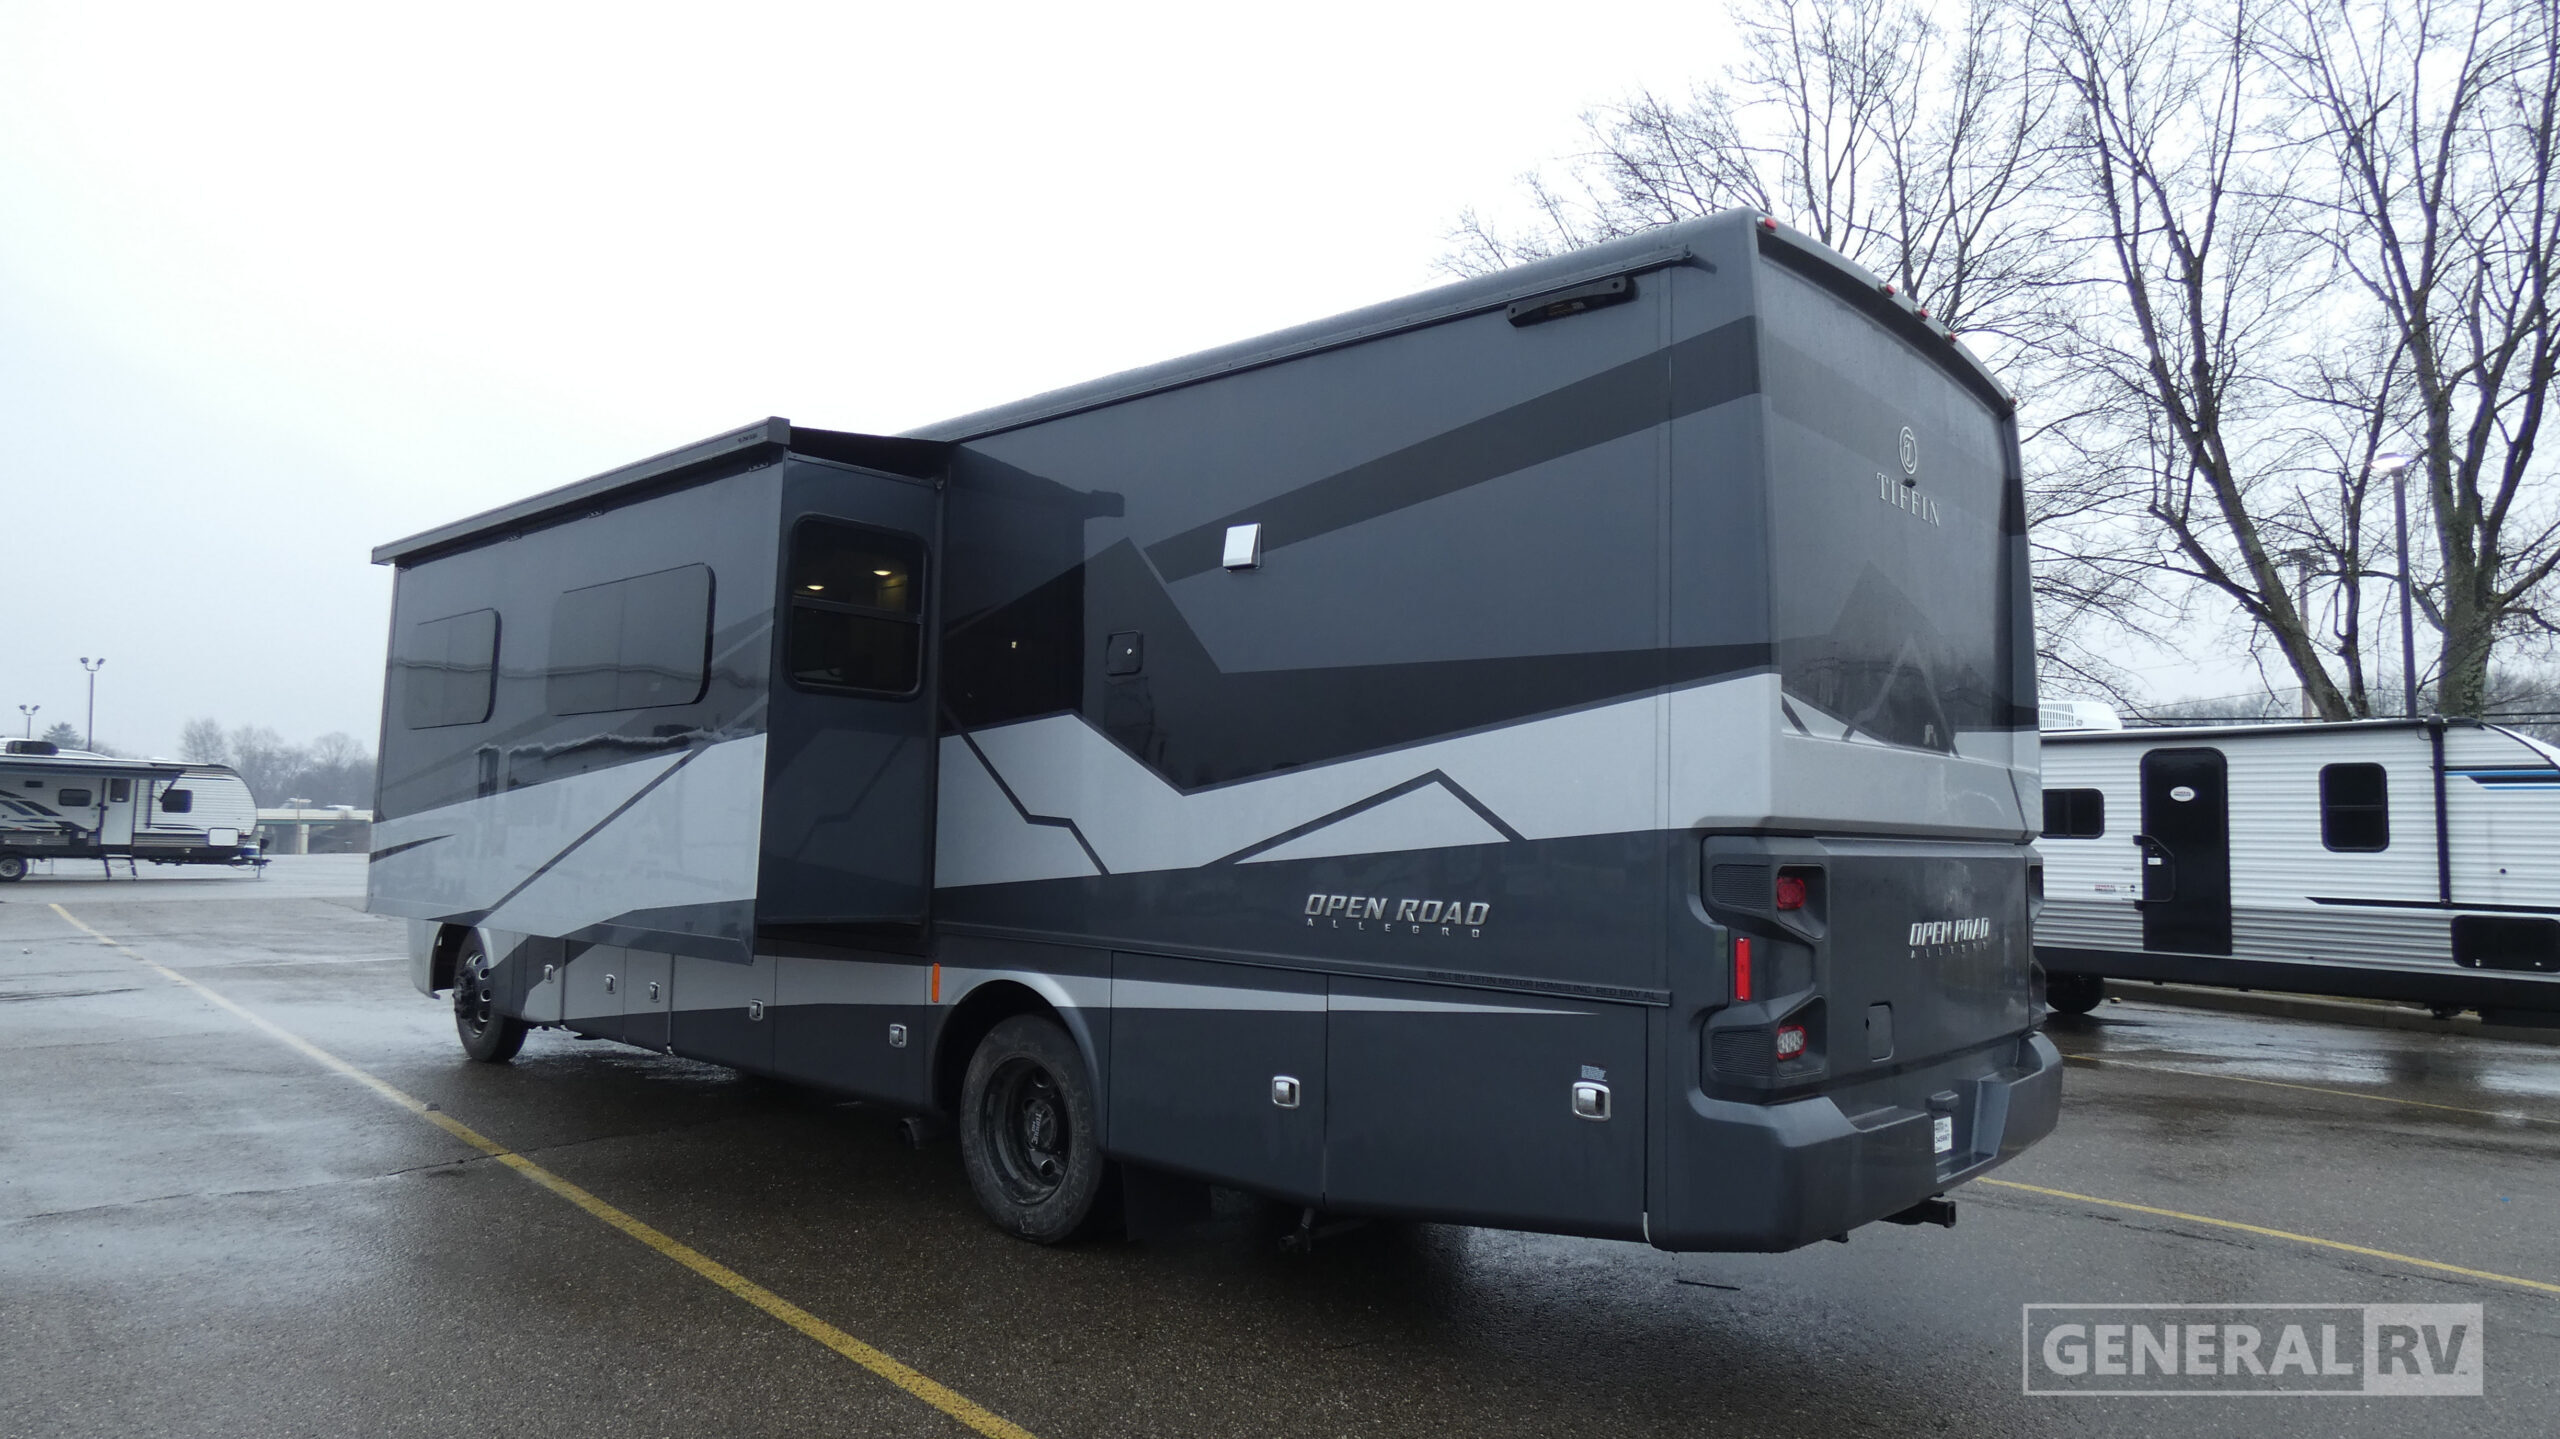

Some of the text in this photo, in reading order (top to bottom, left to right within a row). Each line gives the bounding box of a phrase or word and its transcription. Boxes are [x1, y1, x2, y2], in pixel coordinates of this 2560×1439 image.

[1876, 471, 1940, 527] TIFFIN
[1304, 893, 1490, 926] OPEN ROAD
[1306, 918, 1480, 938] ALLEGRO
[1910, 917, 1990, 946] OPEN ROAD
[1499, 977, 1533, 988] MOTOR
[1596, 986, 1616, 997] RED
[1620, 989, 1640, 998] BAY
